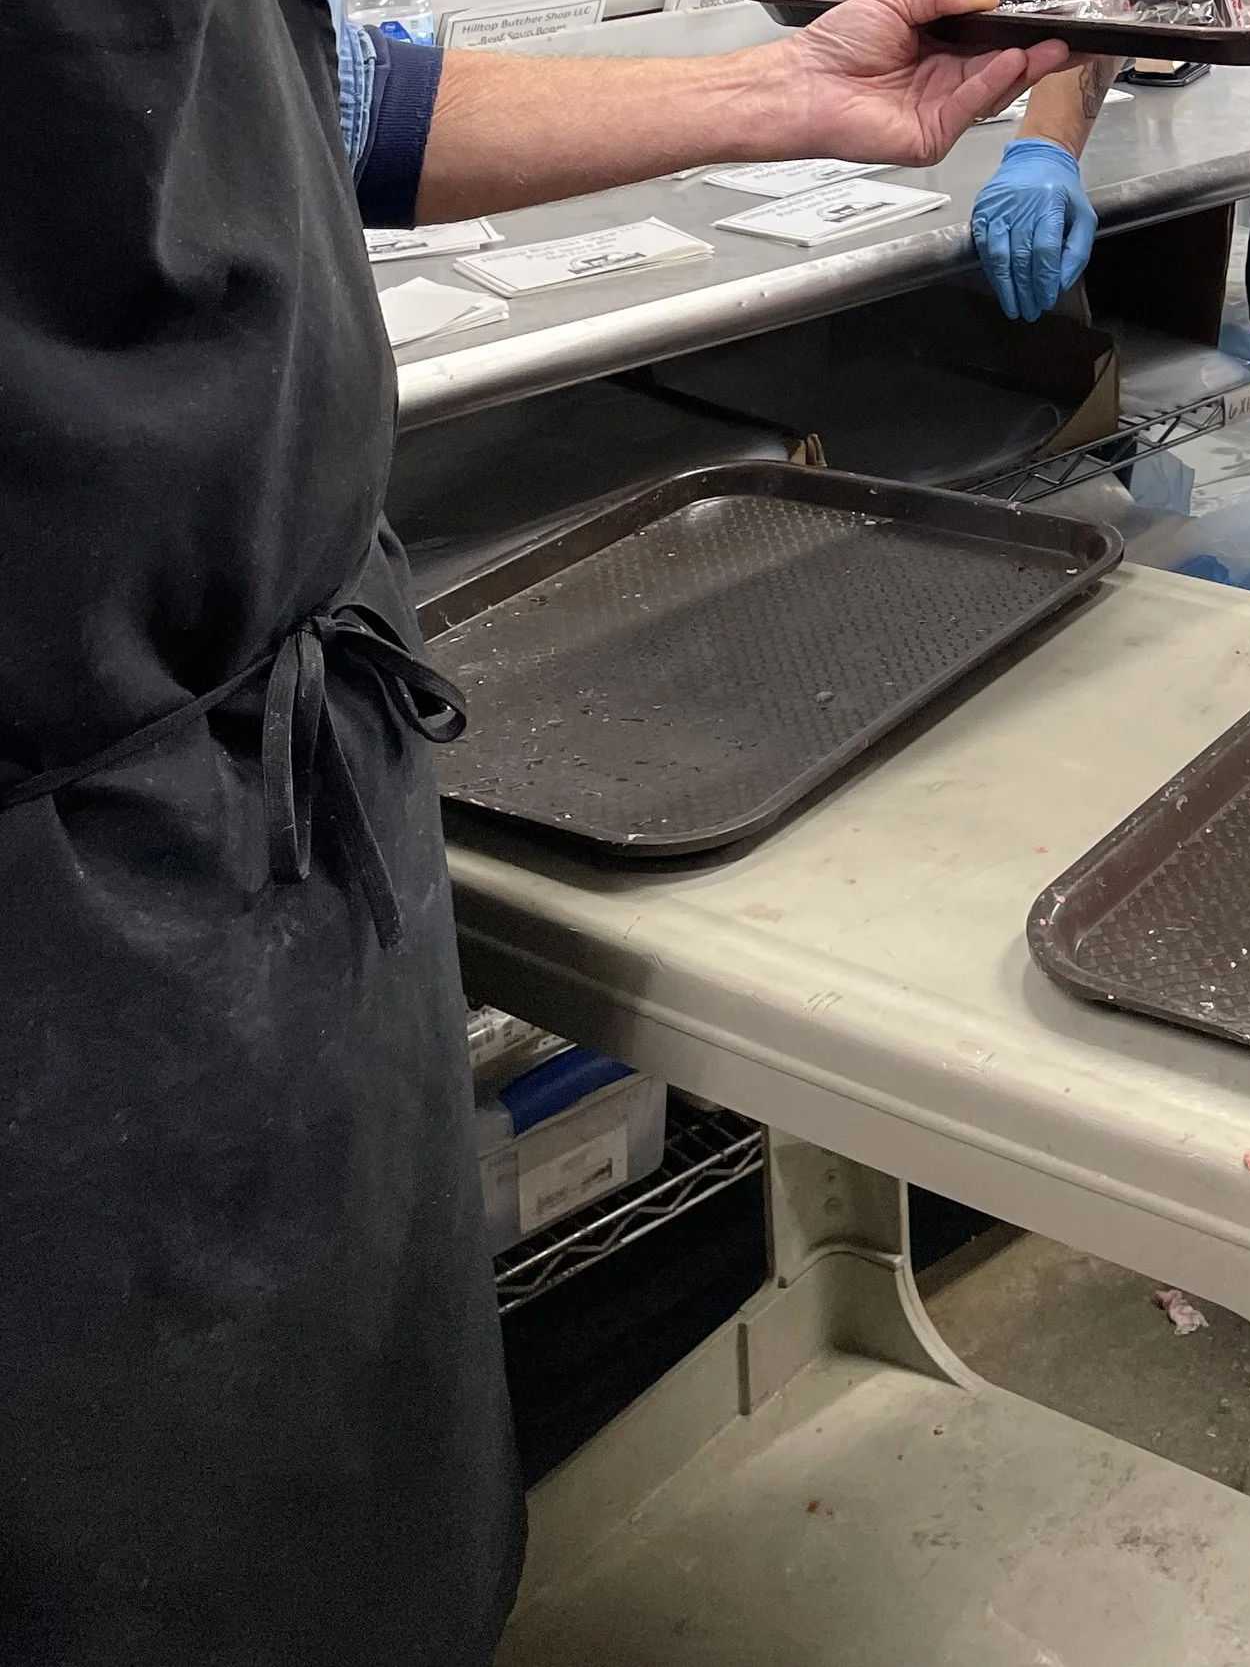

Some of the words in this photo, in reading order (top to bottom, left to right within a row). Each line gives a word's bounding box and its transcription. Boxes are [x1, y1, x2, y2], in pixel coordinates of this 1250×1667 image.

[462, 22, 499, 34] Hilltop
[501, 15, 542, 29] Butcher
[544, 11, 571, 22] Shop
[573, 5, 592, 17] LLC
[480, 33, 506, 45] Beef
